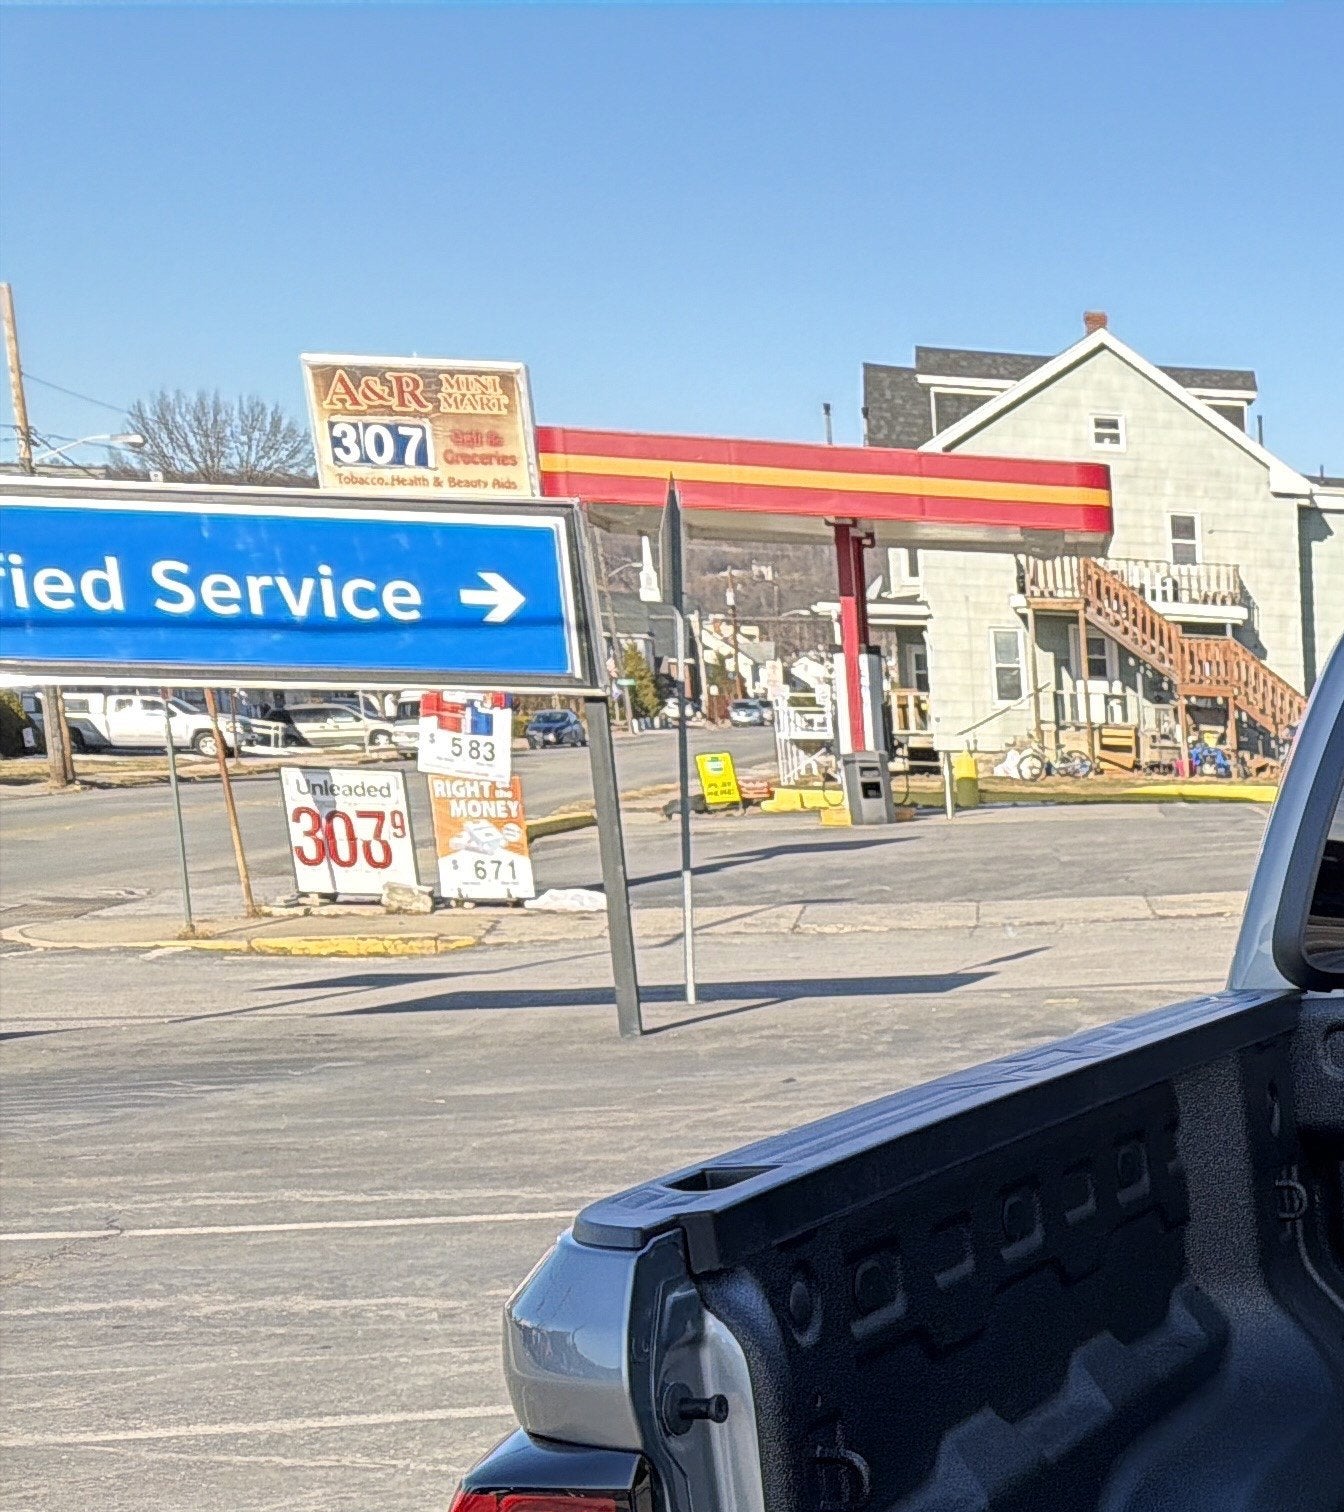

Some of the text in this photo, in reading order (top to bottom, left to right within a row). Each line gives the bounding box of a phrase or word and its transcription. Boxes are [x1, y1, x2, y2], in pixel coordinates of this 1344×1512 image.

[323, 369, 433, 412] A&R
[440, 374, 503, 394] MINI
[438, 393, 507, 415] MART
[332, 422, 423, 465] 307
[150, 558, 422, 622] Service
[296, 779, 392, 798] Unleaded
[433, 779, 492, 798] RIGHT
[450, 800, 521, 819] MONEY
[474, 860, 517, 880] 671
